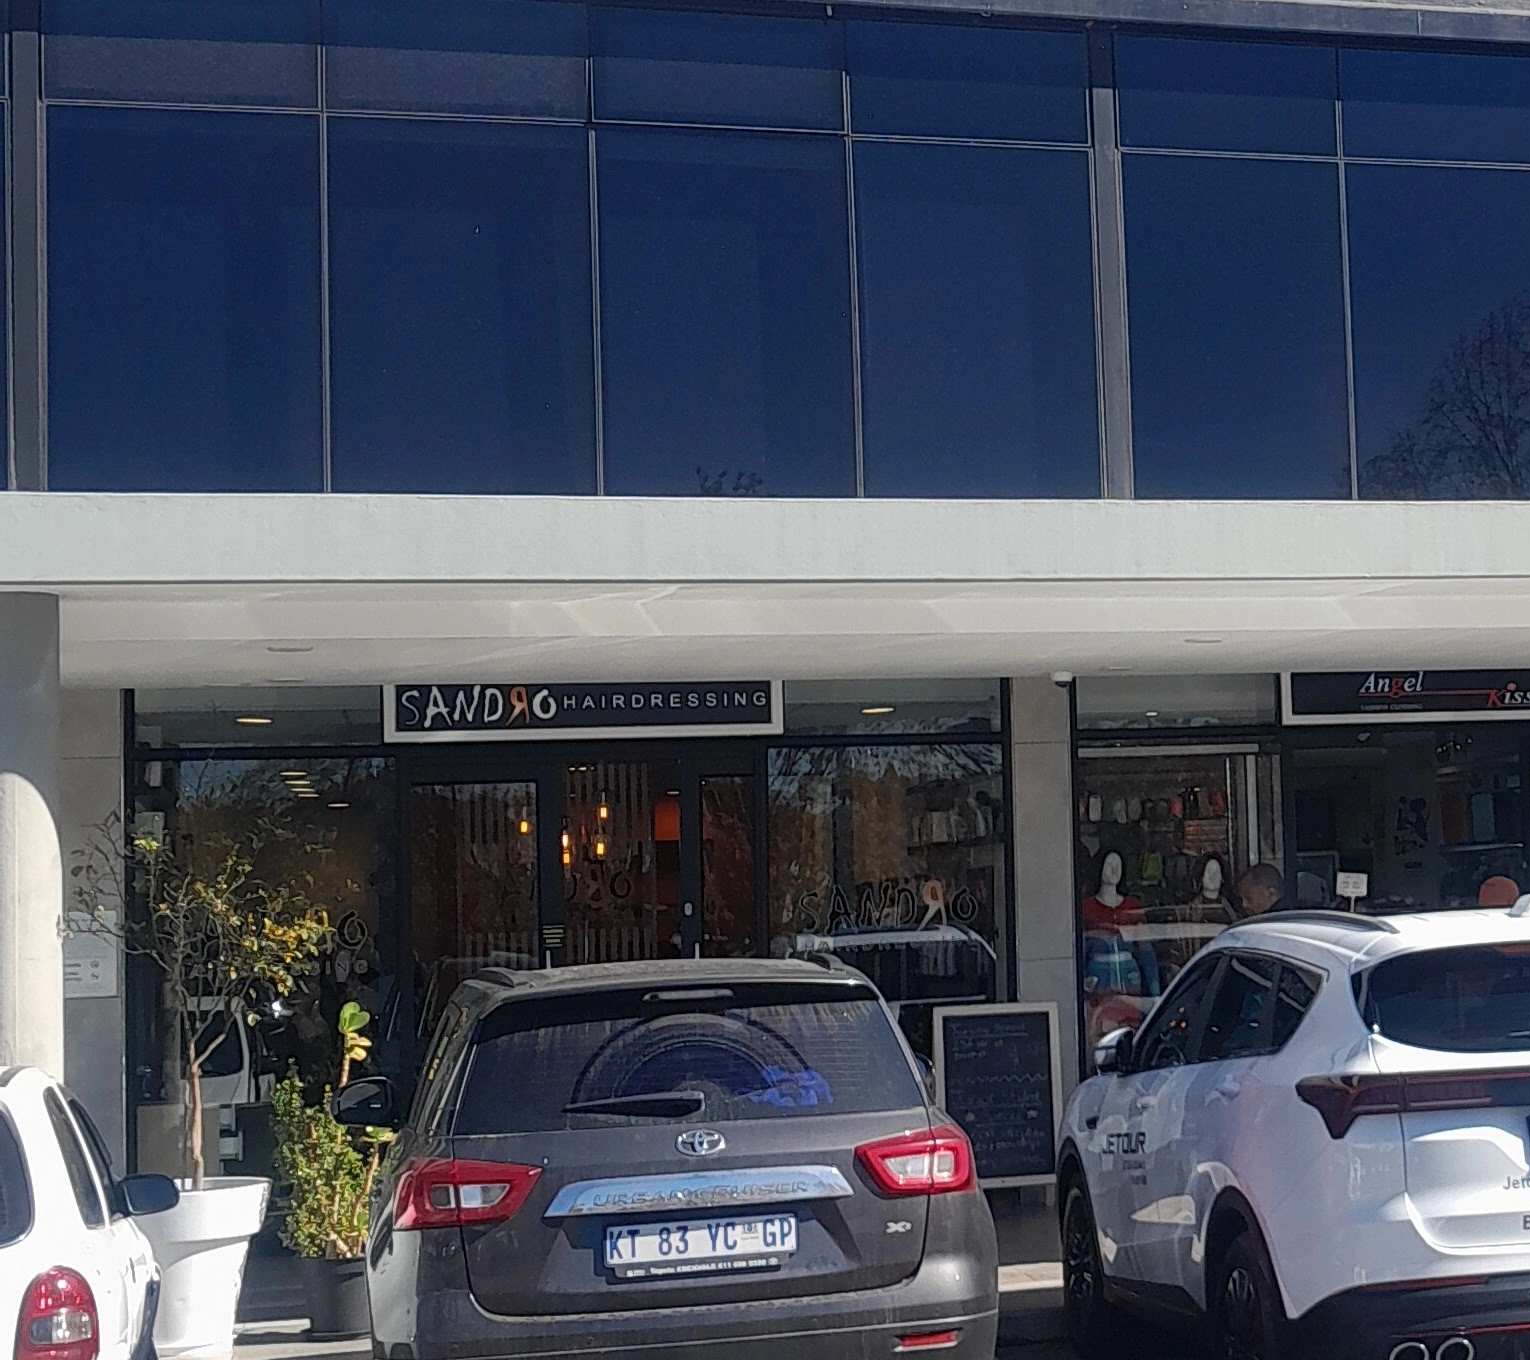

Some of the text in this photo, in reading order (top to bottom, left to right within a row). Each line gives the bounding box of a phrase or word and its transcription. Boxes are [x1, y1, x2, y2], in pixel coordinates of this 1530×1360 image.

[1360, 671, 1425, 699] Angel
[562, 692, 768, 711] HAIRDRESSING
[1102, 1131, 1146, 1155] JETOUR
[608, 1216, 793, 1260] KT 83 YC GP
